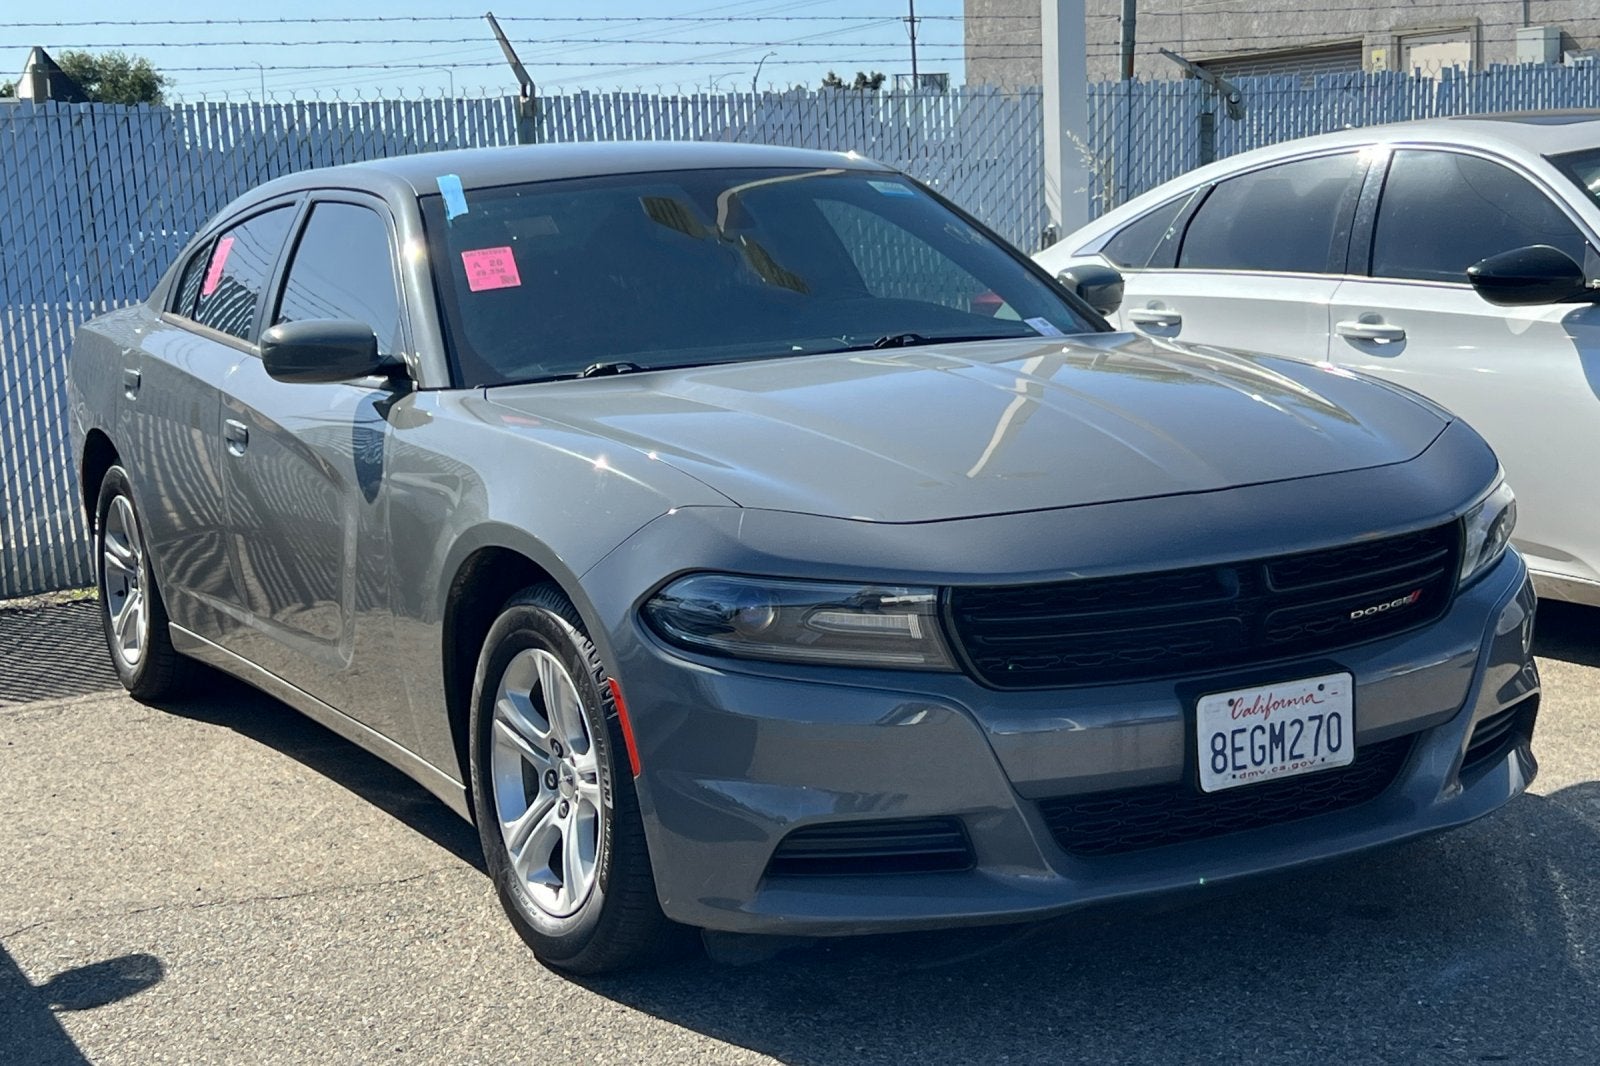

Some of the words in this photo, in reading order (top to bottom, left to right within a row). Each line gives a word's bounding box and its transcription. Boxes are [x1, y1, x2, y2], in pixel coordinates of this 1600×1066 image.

[1350, 595, 1412, 619] DODGE
[1231, 693, 1324, 720] California
[1210, 712, 1342, 774] 8EGM270
[1239, 759, 1316, 779] dmv.ca.gov
